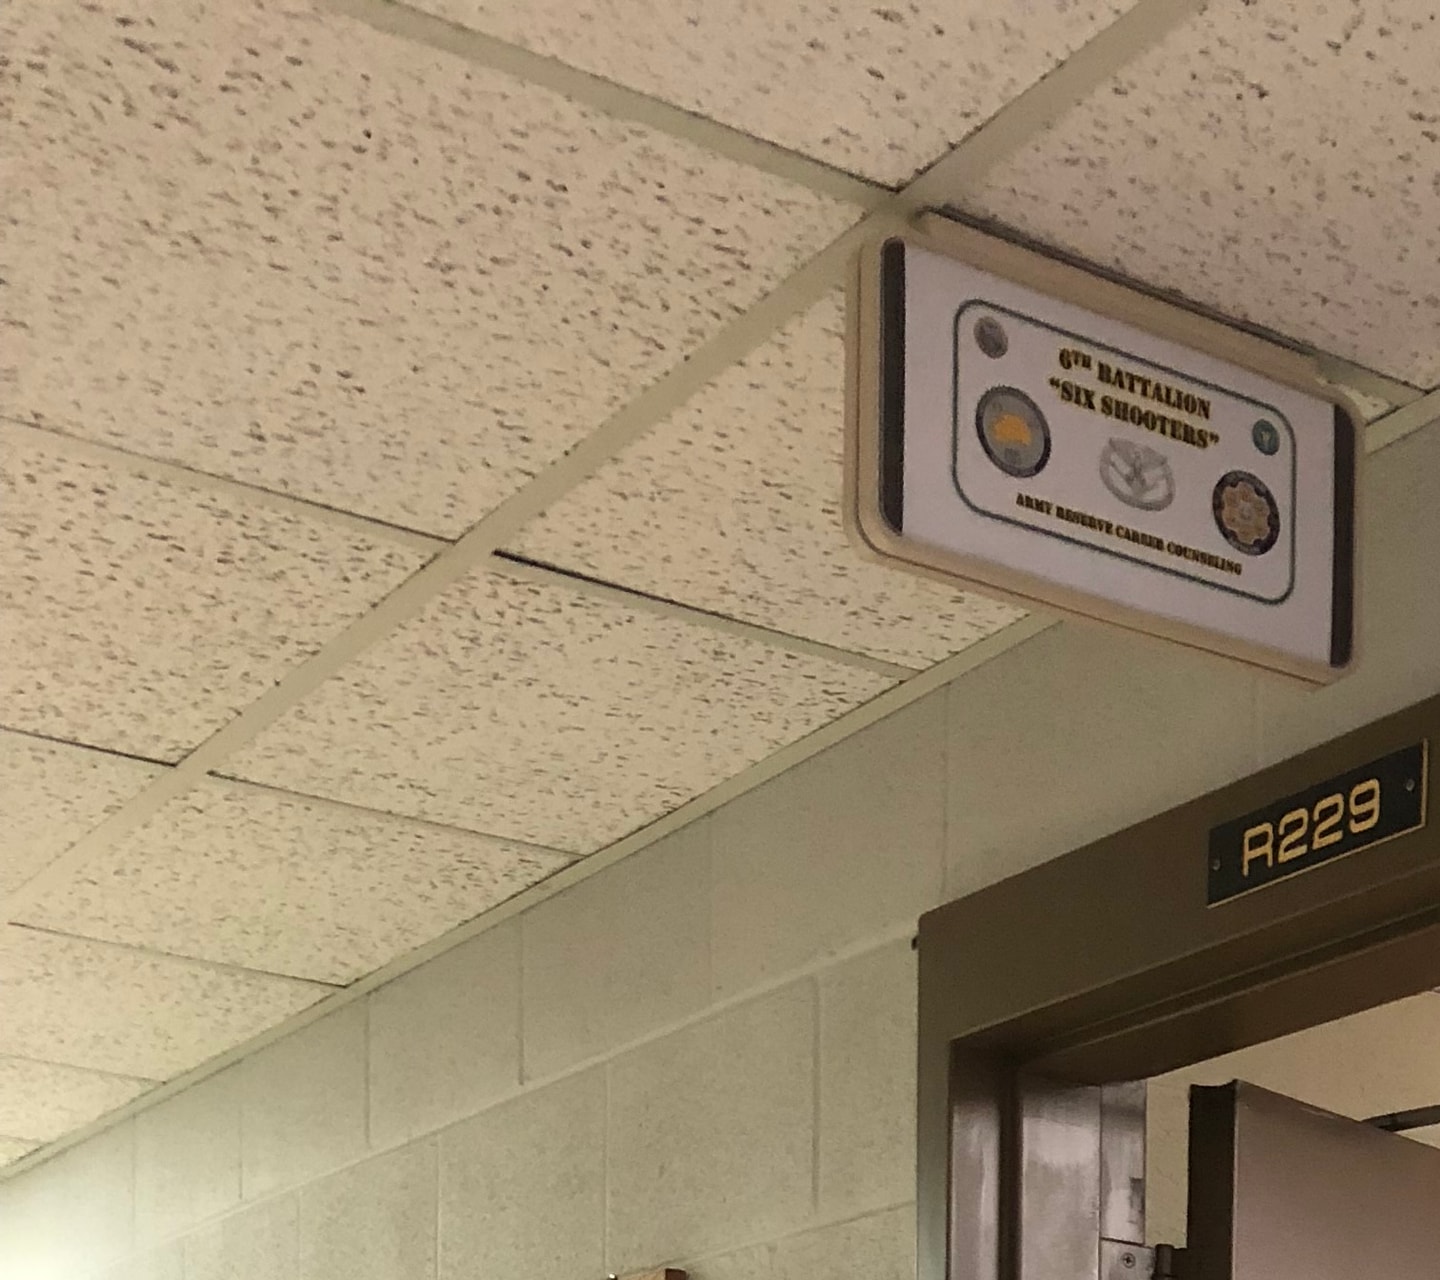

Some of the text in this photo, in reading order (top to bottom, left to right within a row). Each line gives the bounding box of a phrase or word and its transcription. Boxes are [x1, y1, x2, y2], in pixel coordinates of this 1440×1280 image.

[1097, 360, 1211, 420] BATTALION
[1016, 493, 1243, 576] ARMY RESERVE CAREER COUNSELING
[1242, 778, 1381, 876] R229
